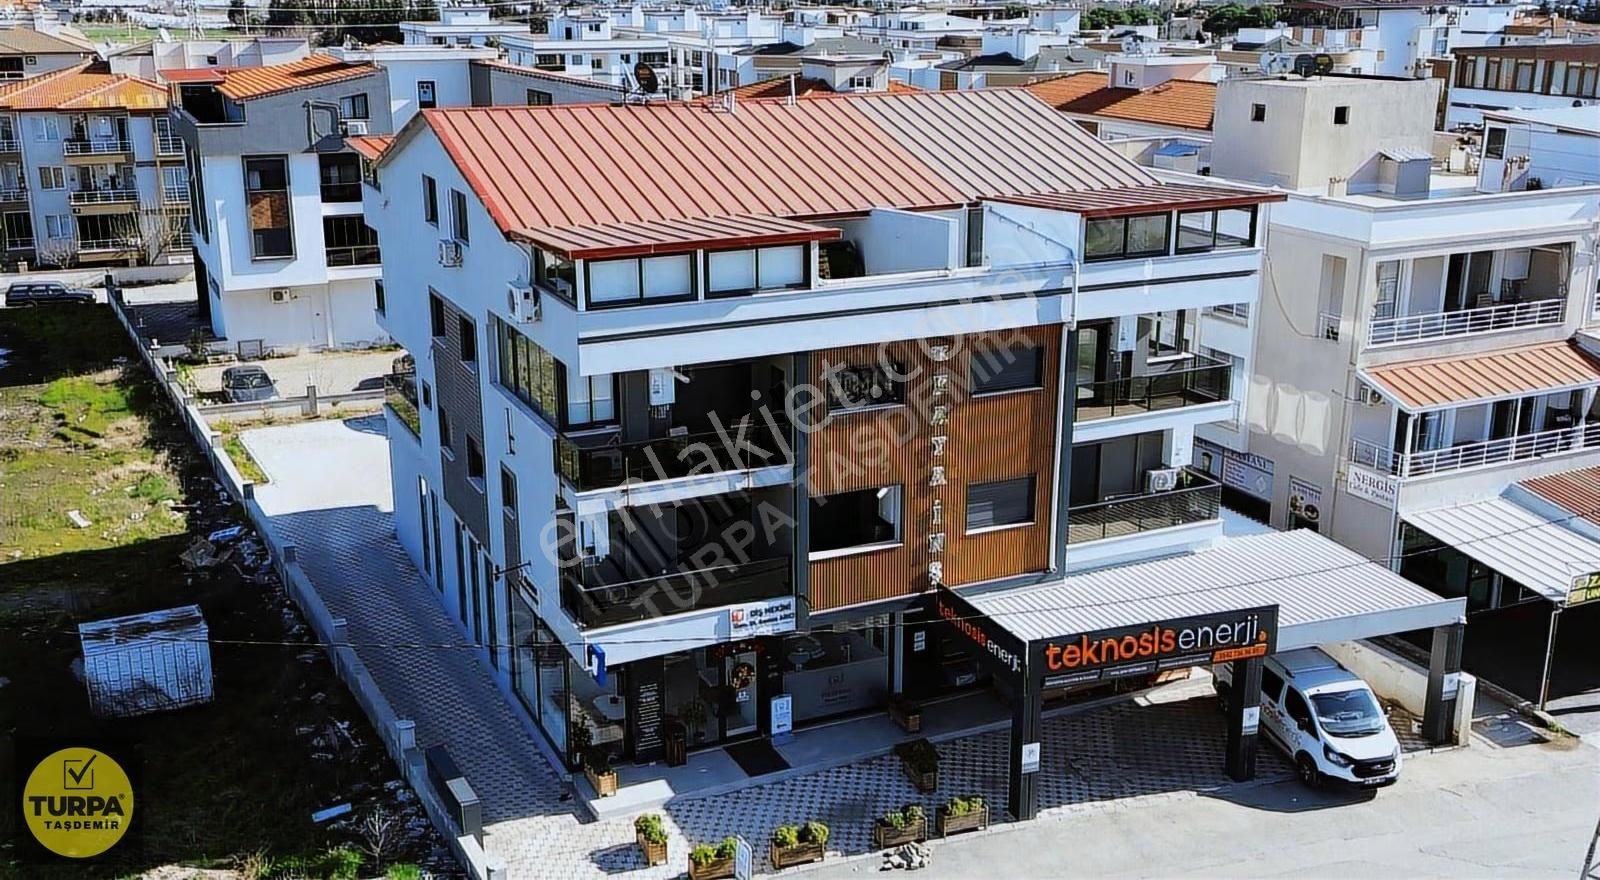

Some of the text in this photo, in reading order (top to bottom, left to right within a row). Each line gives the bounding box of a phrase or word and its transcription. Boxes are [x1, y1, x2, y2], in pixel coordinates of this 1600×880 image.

[1353, 471, 1395, 495] NERGİS
[751, 608, 763, 617] DİŞ
[938, 599, 986, 647] teknosis
[987, 639, 1021, 673] enerji
[1046, 625, 1176, 671] teknosis
